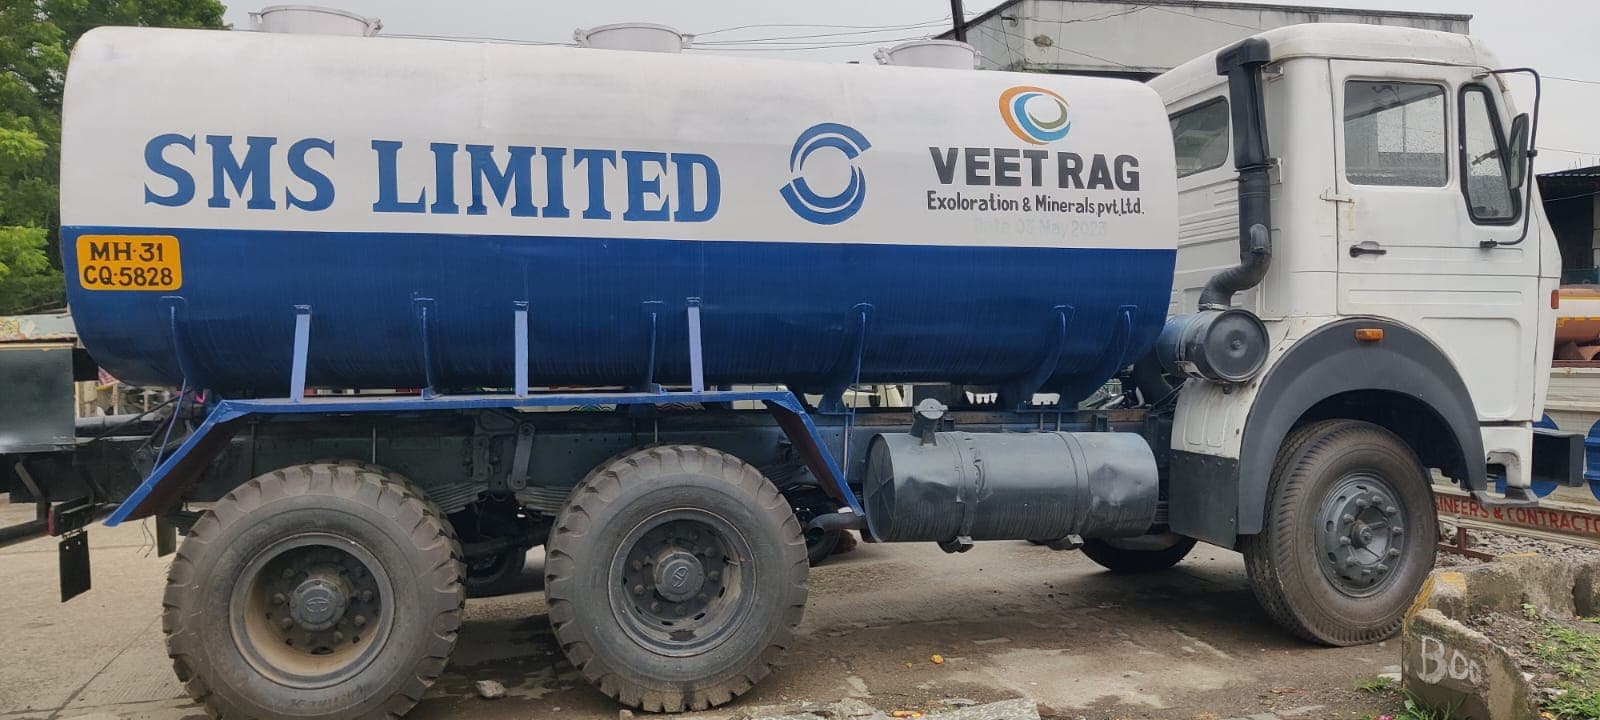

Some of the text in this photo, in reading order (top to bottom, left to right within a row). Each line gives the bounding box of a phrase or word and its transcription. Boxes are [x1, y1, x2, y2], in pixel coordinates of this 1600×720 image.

[143, 133, 721, 222] SMS LIMITED
[929, 147, 1140, 191] VEET RAG
[927, 190, 1019, 211] Exoloration
[1022, 197, 1032, 212] &
[1035, 194, 1095, 214] Minerals
[1435, 495, 1489, 519] INEERS
[1493, 506, 1504, 520] &
